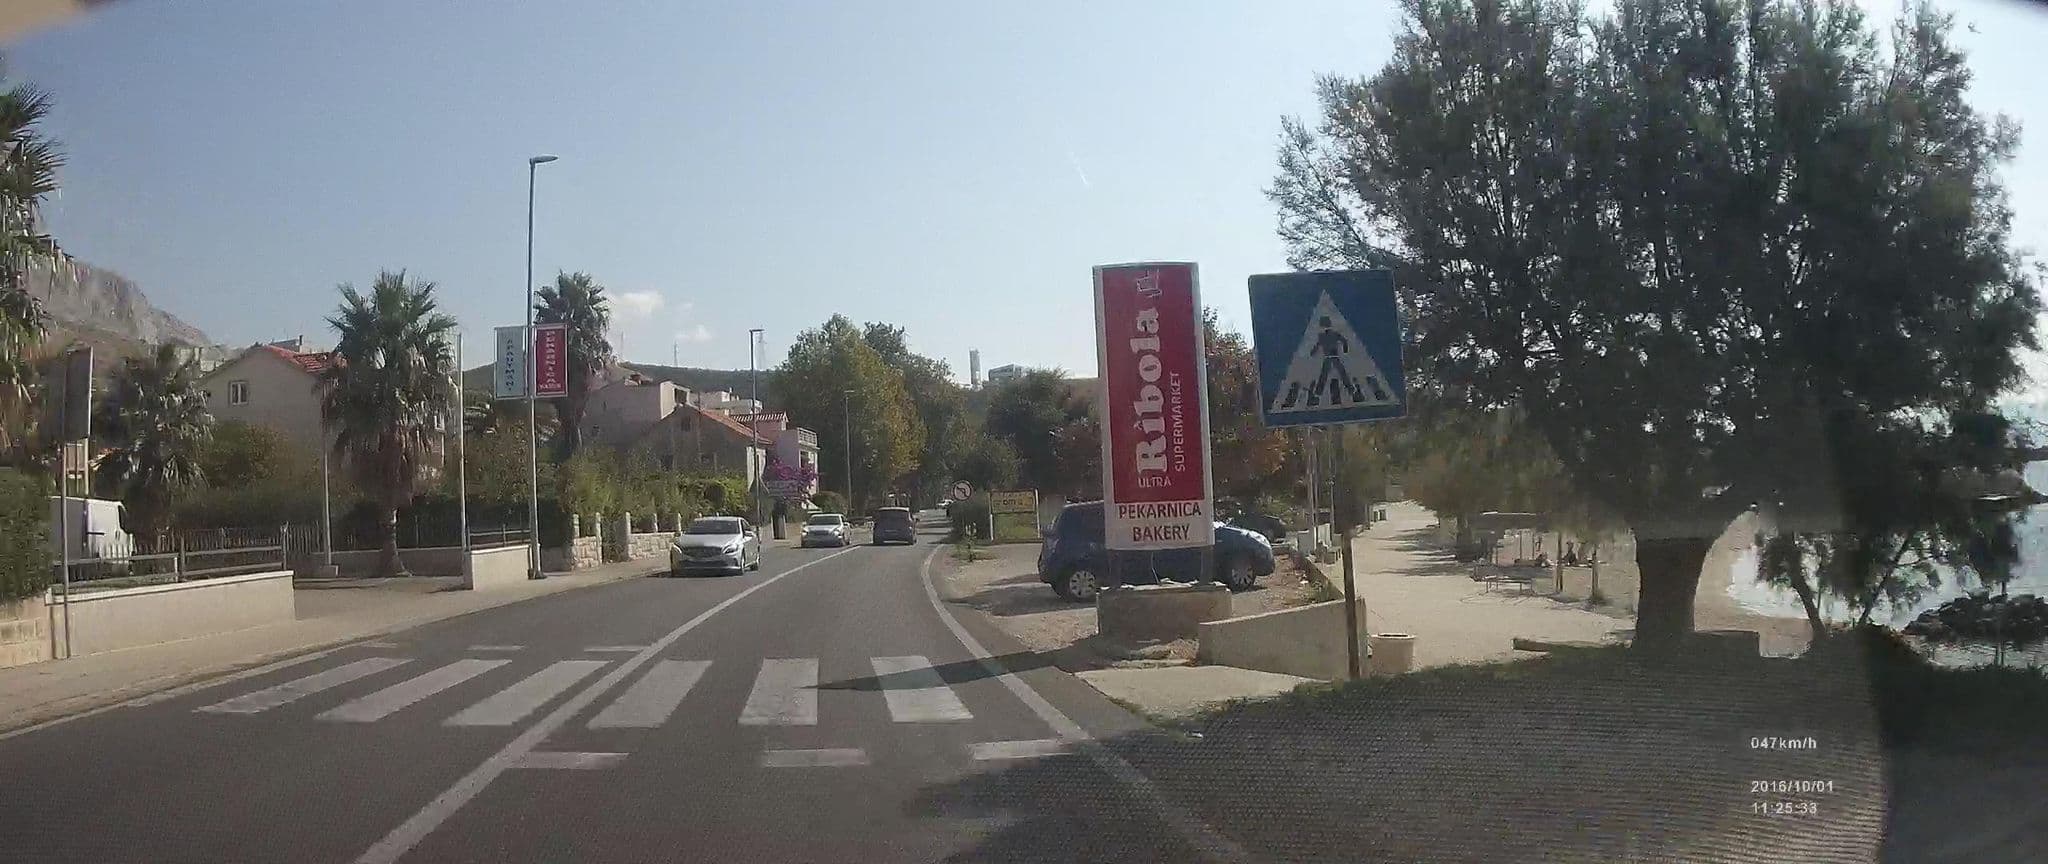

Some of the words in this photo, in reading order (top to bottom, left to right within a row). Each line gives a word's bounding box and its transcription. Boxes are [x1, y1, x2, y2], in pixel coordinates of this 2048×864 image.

[1130, 307, 1168, 473] Ribola
[1170, 371, 1185, 472] SUPERMARKET
[1138, 476, 1172, 488] ULTRA
[1119, 502, 1202, 519] PEKARNICA
[1133, 524, 1190, 542] BAKERY
